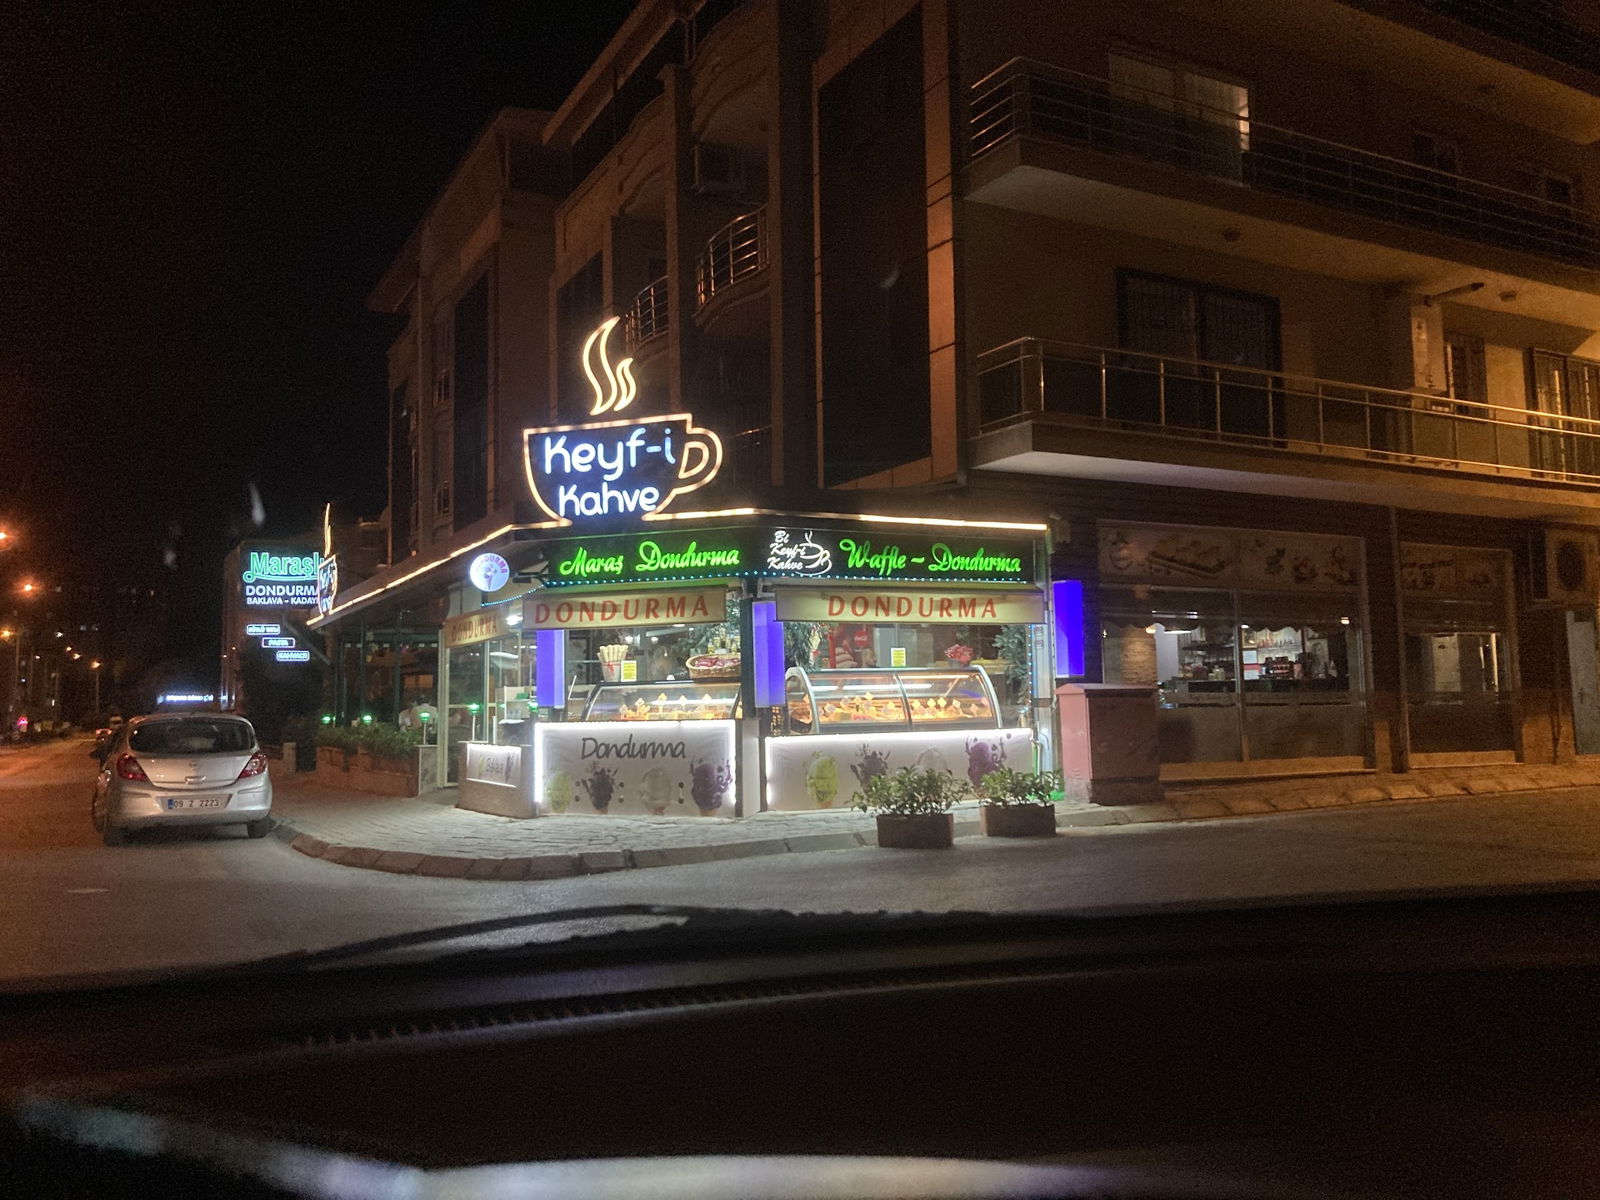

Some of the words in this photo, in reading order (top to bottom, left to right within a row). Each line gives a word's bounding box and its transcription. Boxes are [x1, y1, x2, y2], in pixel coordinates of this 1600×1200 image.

[544, 427, 676, 481] Keyf-i
[558, 482, 660, 517] Kahve
[635, 540, 740, 572] Dondurma
[766, 556, 804, 571] Kahve
[838, 537, 906, 576] Waffle
[927, 542, 1022, 573] Dondurma
[246, 597, 283, 605] BAKLAVA
[534, 595, 709, 623] DONDURMA
[827, 595, 997, 618] DONDURMA
[451, 615, 498, 642] DONDURMA
[581, 733, 687, 760] Dondurma
